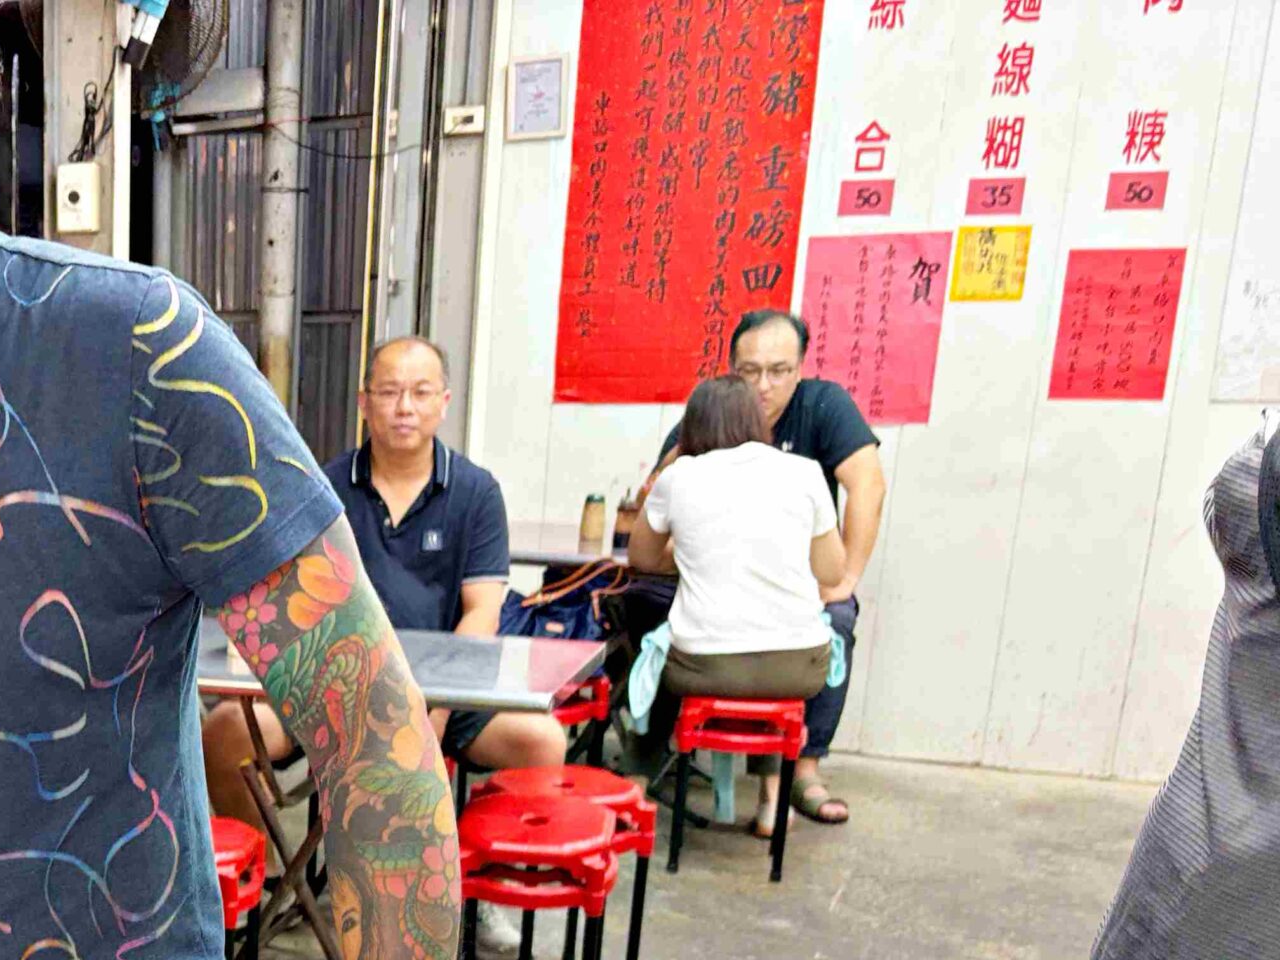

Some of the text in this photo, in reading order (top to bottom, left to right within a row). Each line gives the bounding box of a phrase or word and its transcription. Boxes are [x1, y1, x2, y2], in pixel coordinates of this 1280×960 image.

[854, 188, 881, 208] 50
[981, 185, 1013, 208] 35
[1125, 181, 1153, 203] 50
[908, 257, 942, 306] 賀
